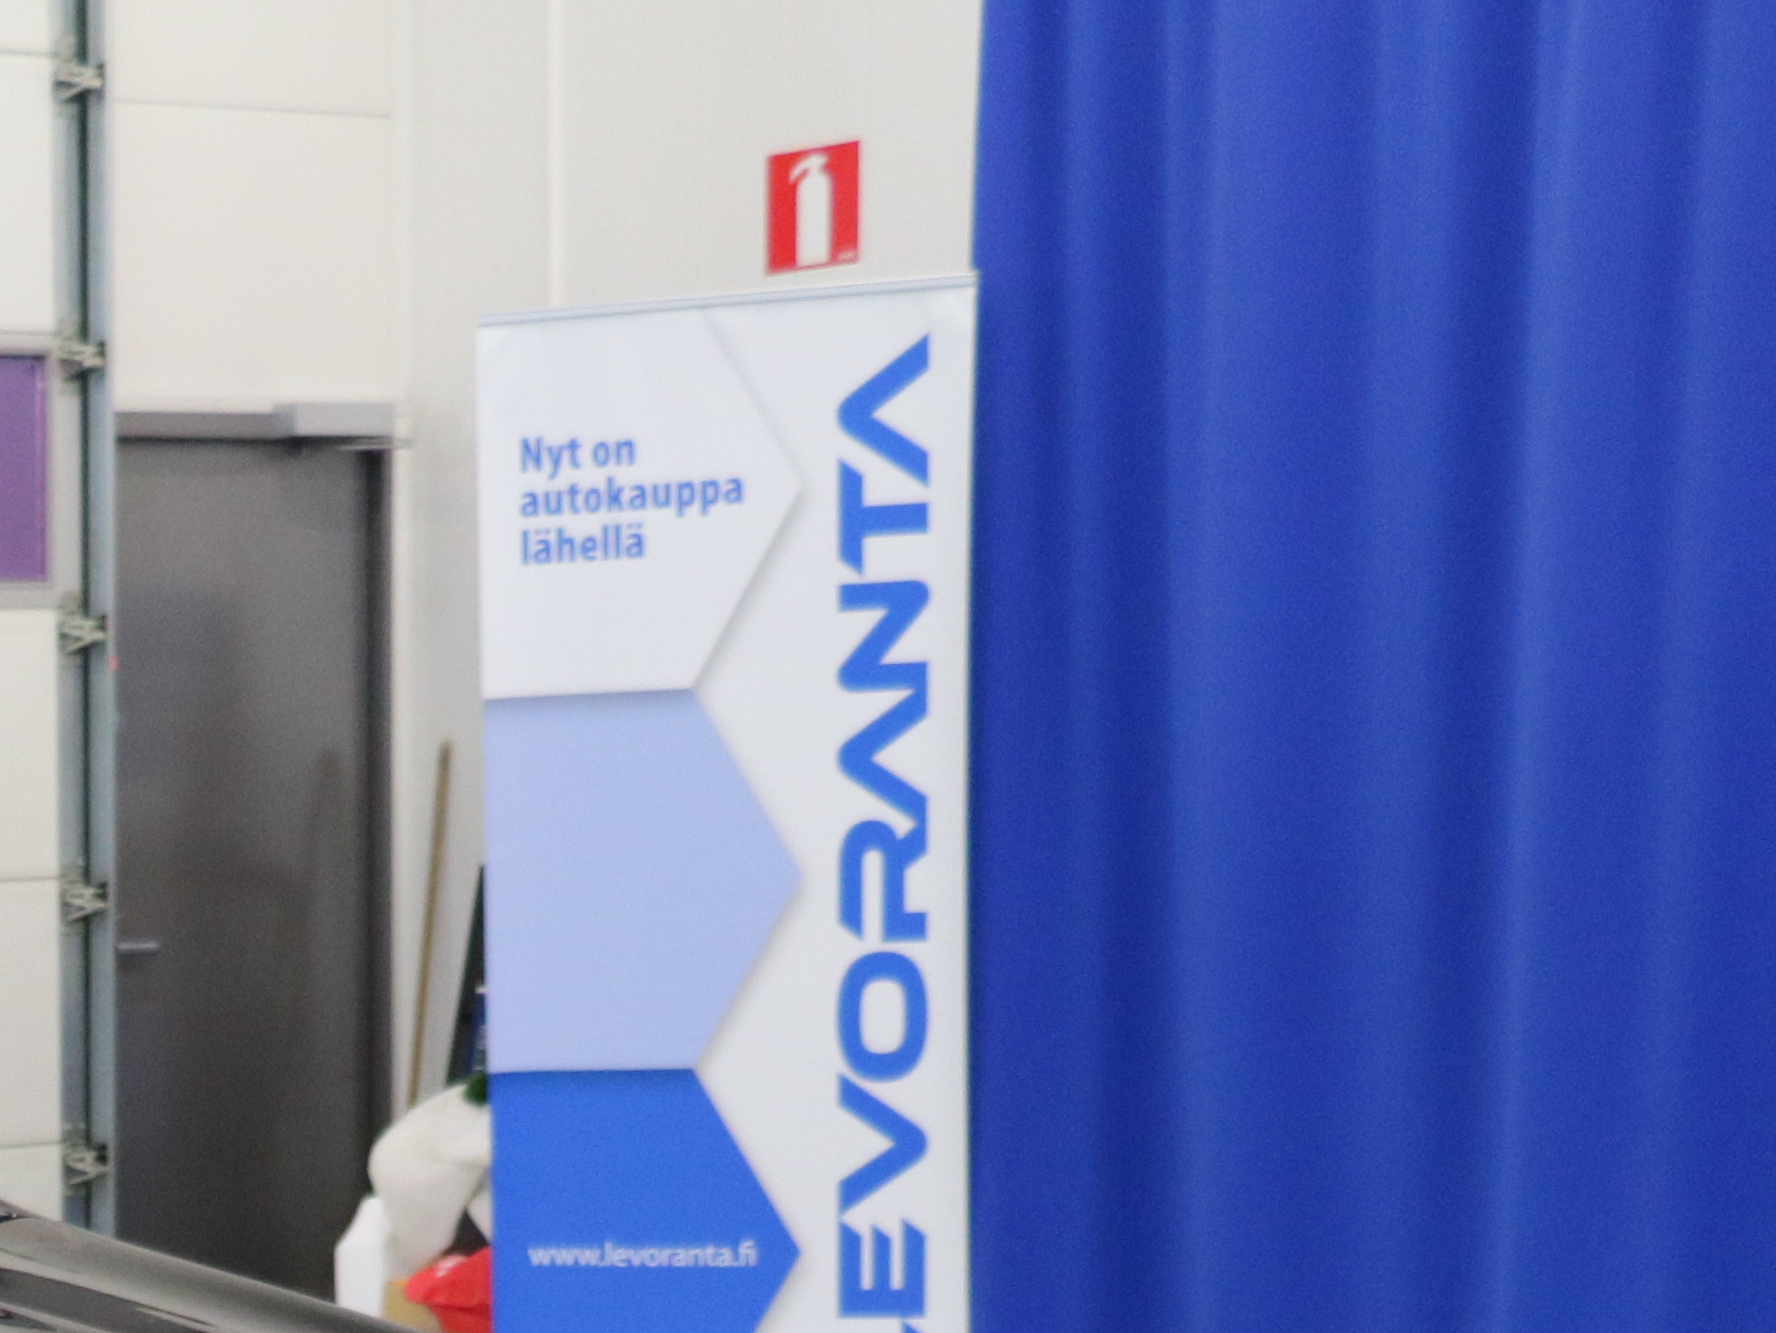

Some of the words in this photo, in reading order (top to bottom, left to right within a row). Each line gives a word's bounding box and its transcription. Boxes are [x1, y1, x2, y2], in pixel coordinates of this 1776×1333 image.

[519, 437, 581, 479] Nyt
[592, 438, 636, 467] on
[520, 477, 745, 517] autokauppa
[520, 523, 647, 565] lähellä
[528, 1240, 758, 1268] www.levoranta.fi
